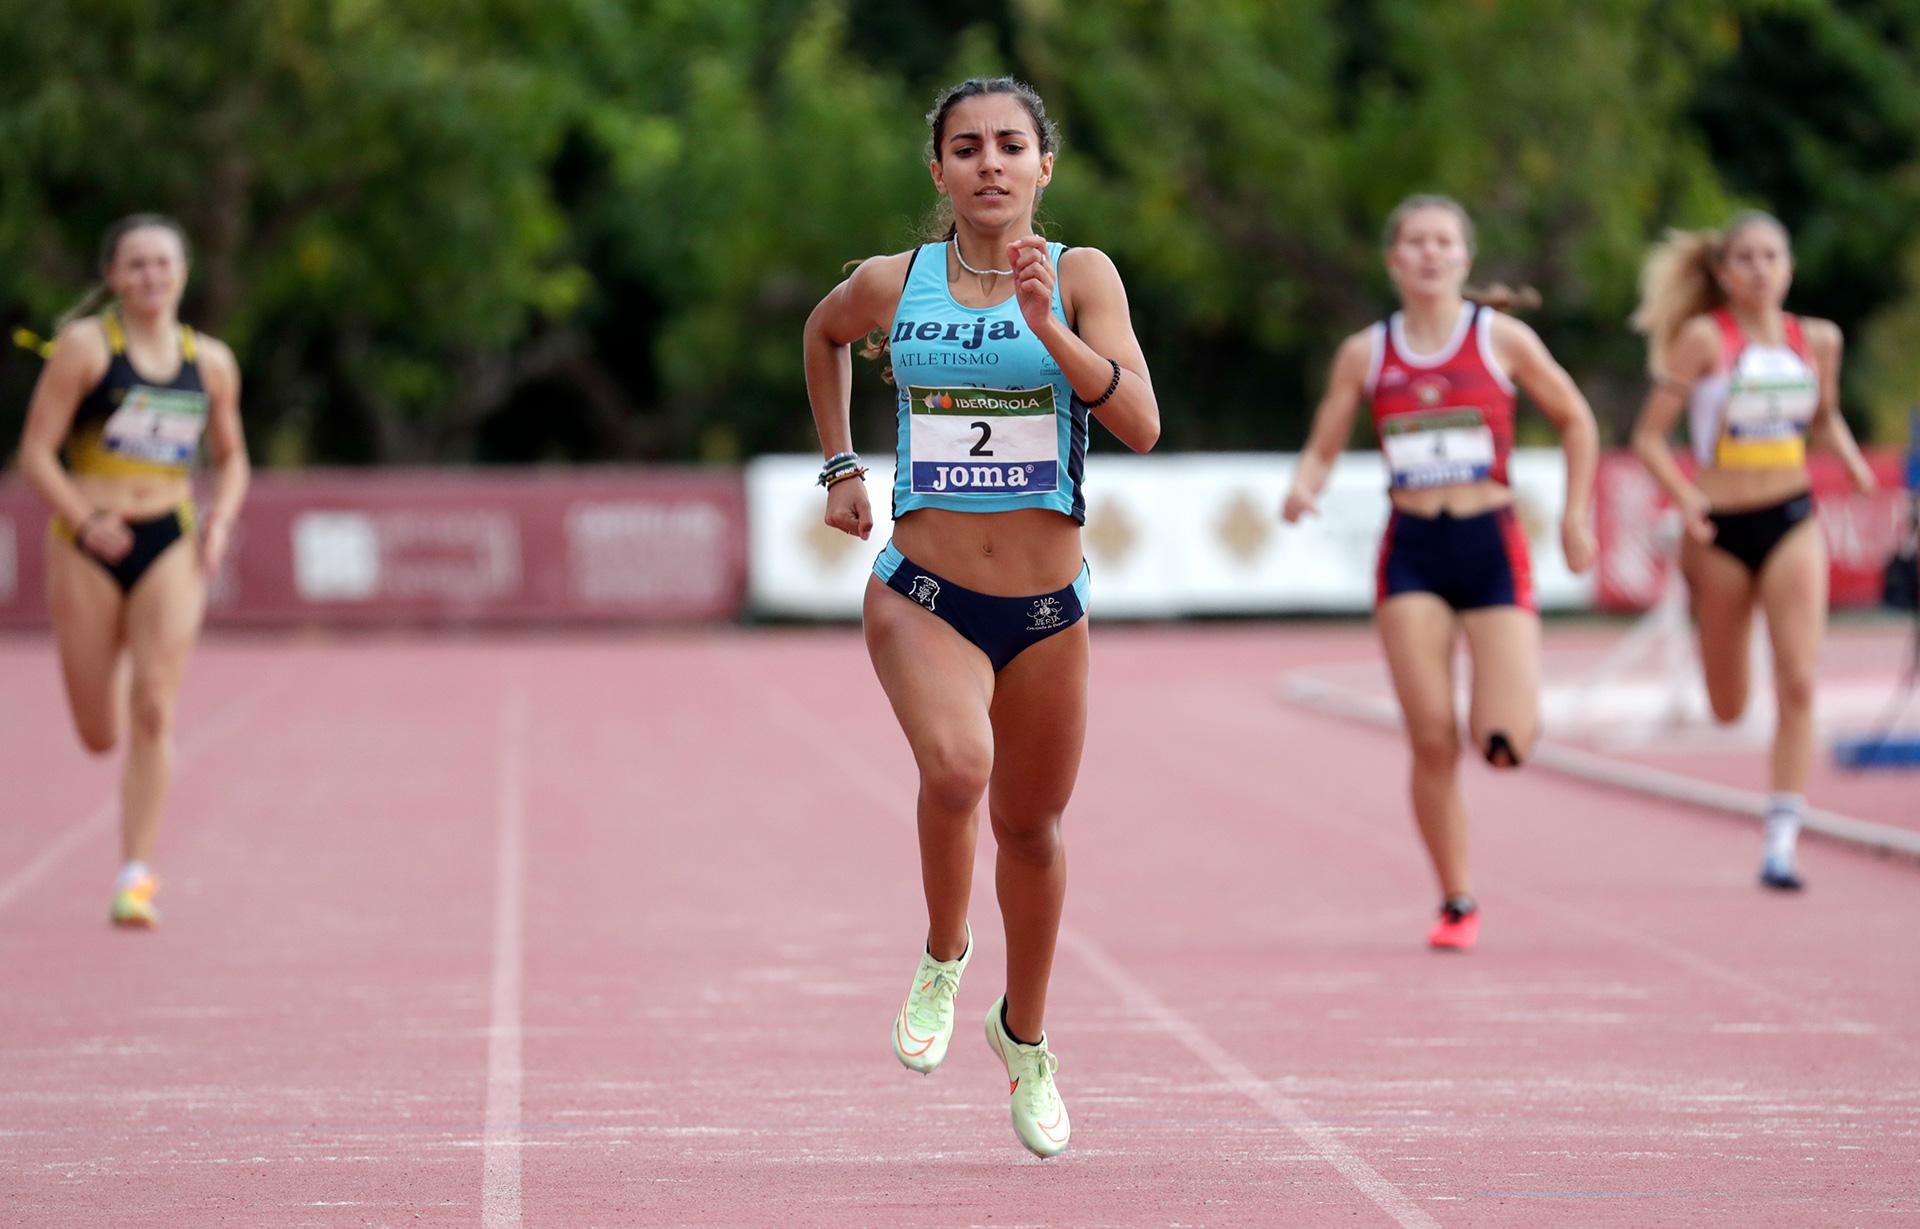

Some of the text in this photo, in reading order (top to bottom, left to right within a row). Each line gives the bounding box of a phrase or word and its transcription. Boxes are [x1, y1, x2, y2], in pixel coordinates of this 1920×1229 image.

[892, 317, 1020, 350] nerja
[899, 352, 1000, 368] ATLETISMO
[955, 397, 1040, 410] IBERDROLA
[969, 421, 994, 457] 2
